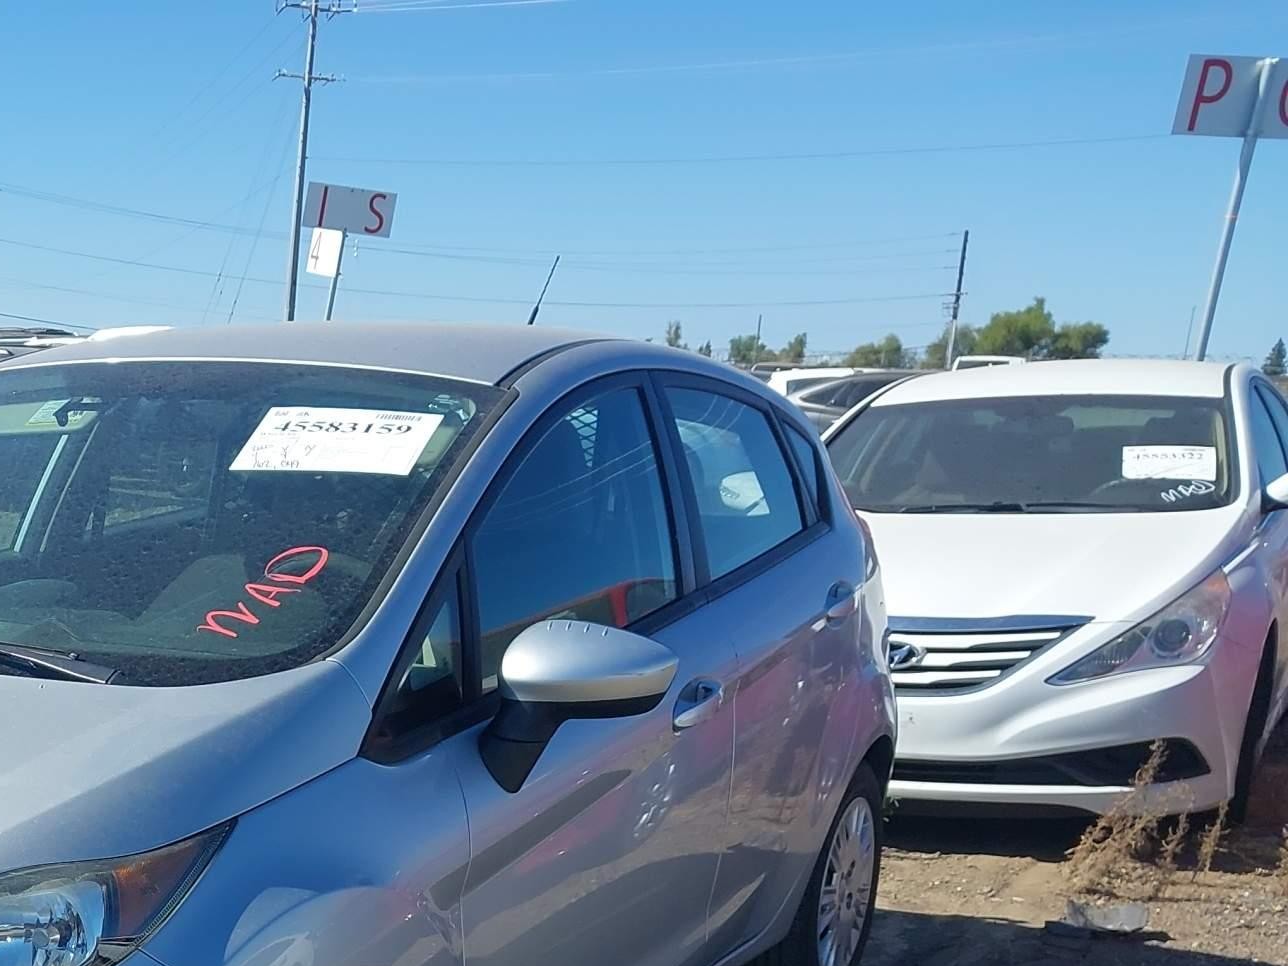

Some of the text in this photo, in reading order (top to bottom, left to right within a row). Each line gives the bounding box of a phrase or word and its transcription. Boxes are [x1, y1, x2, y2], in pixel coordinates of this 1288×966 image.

[1187, 59, 1233, 132] P
[364, 193, 387, 234] S
[311, 231, 322, 270] 4
[274, 420, 413, 435] 45583159
